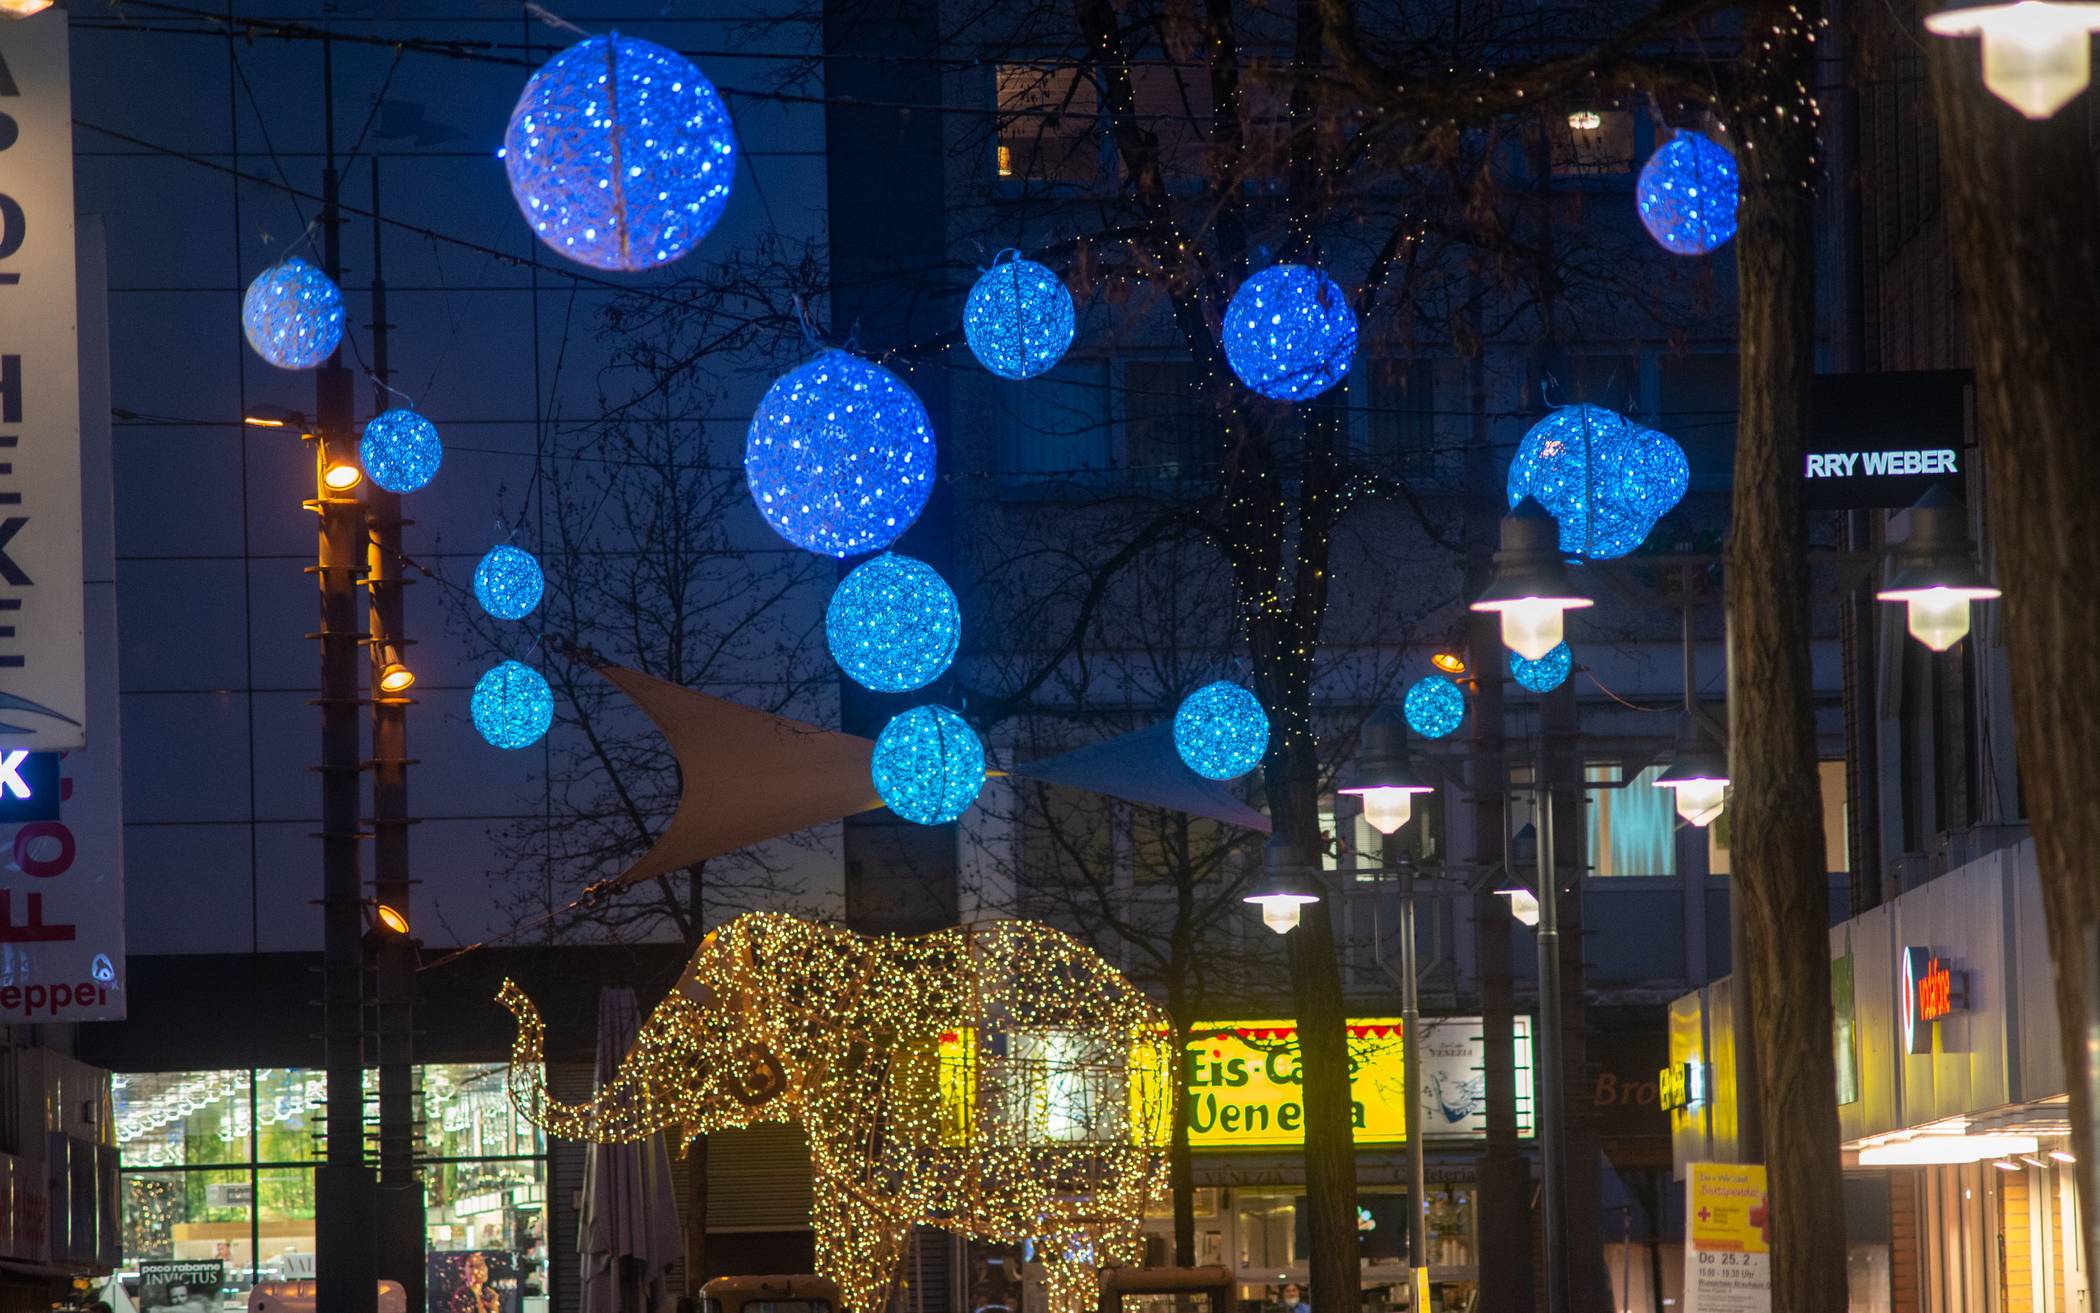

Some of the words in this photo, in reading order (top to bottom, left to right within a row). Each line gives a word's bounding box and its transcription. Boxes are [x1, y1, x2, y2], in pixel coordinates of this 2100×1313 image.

[1862, 450, 1957, 476] WEBER
[1189, 1092, 1367, 1133] Venea
[1204, 1170, 1284, 1185] VENEZIA
[1393, 1167, 1477, 1183] Cfeteria
[1699, 1252, 1715, 1264] Do
[1721, 1253, 1739, 1265] 25.
[142, 1265, 171, 1274] paco
[172, 1262, 221, 1271] rabanne
[1741, 1271, 1755, 1279] Uhr
[146, 1271, 217, 1286] INVICTUS
